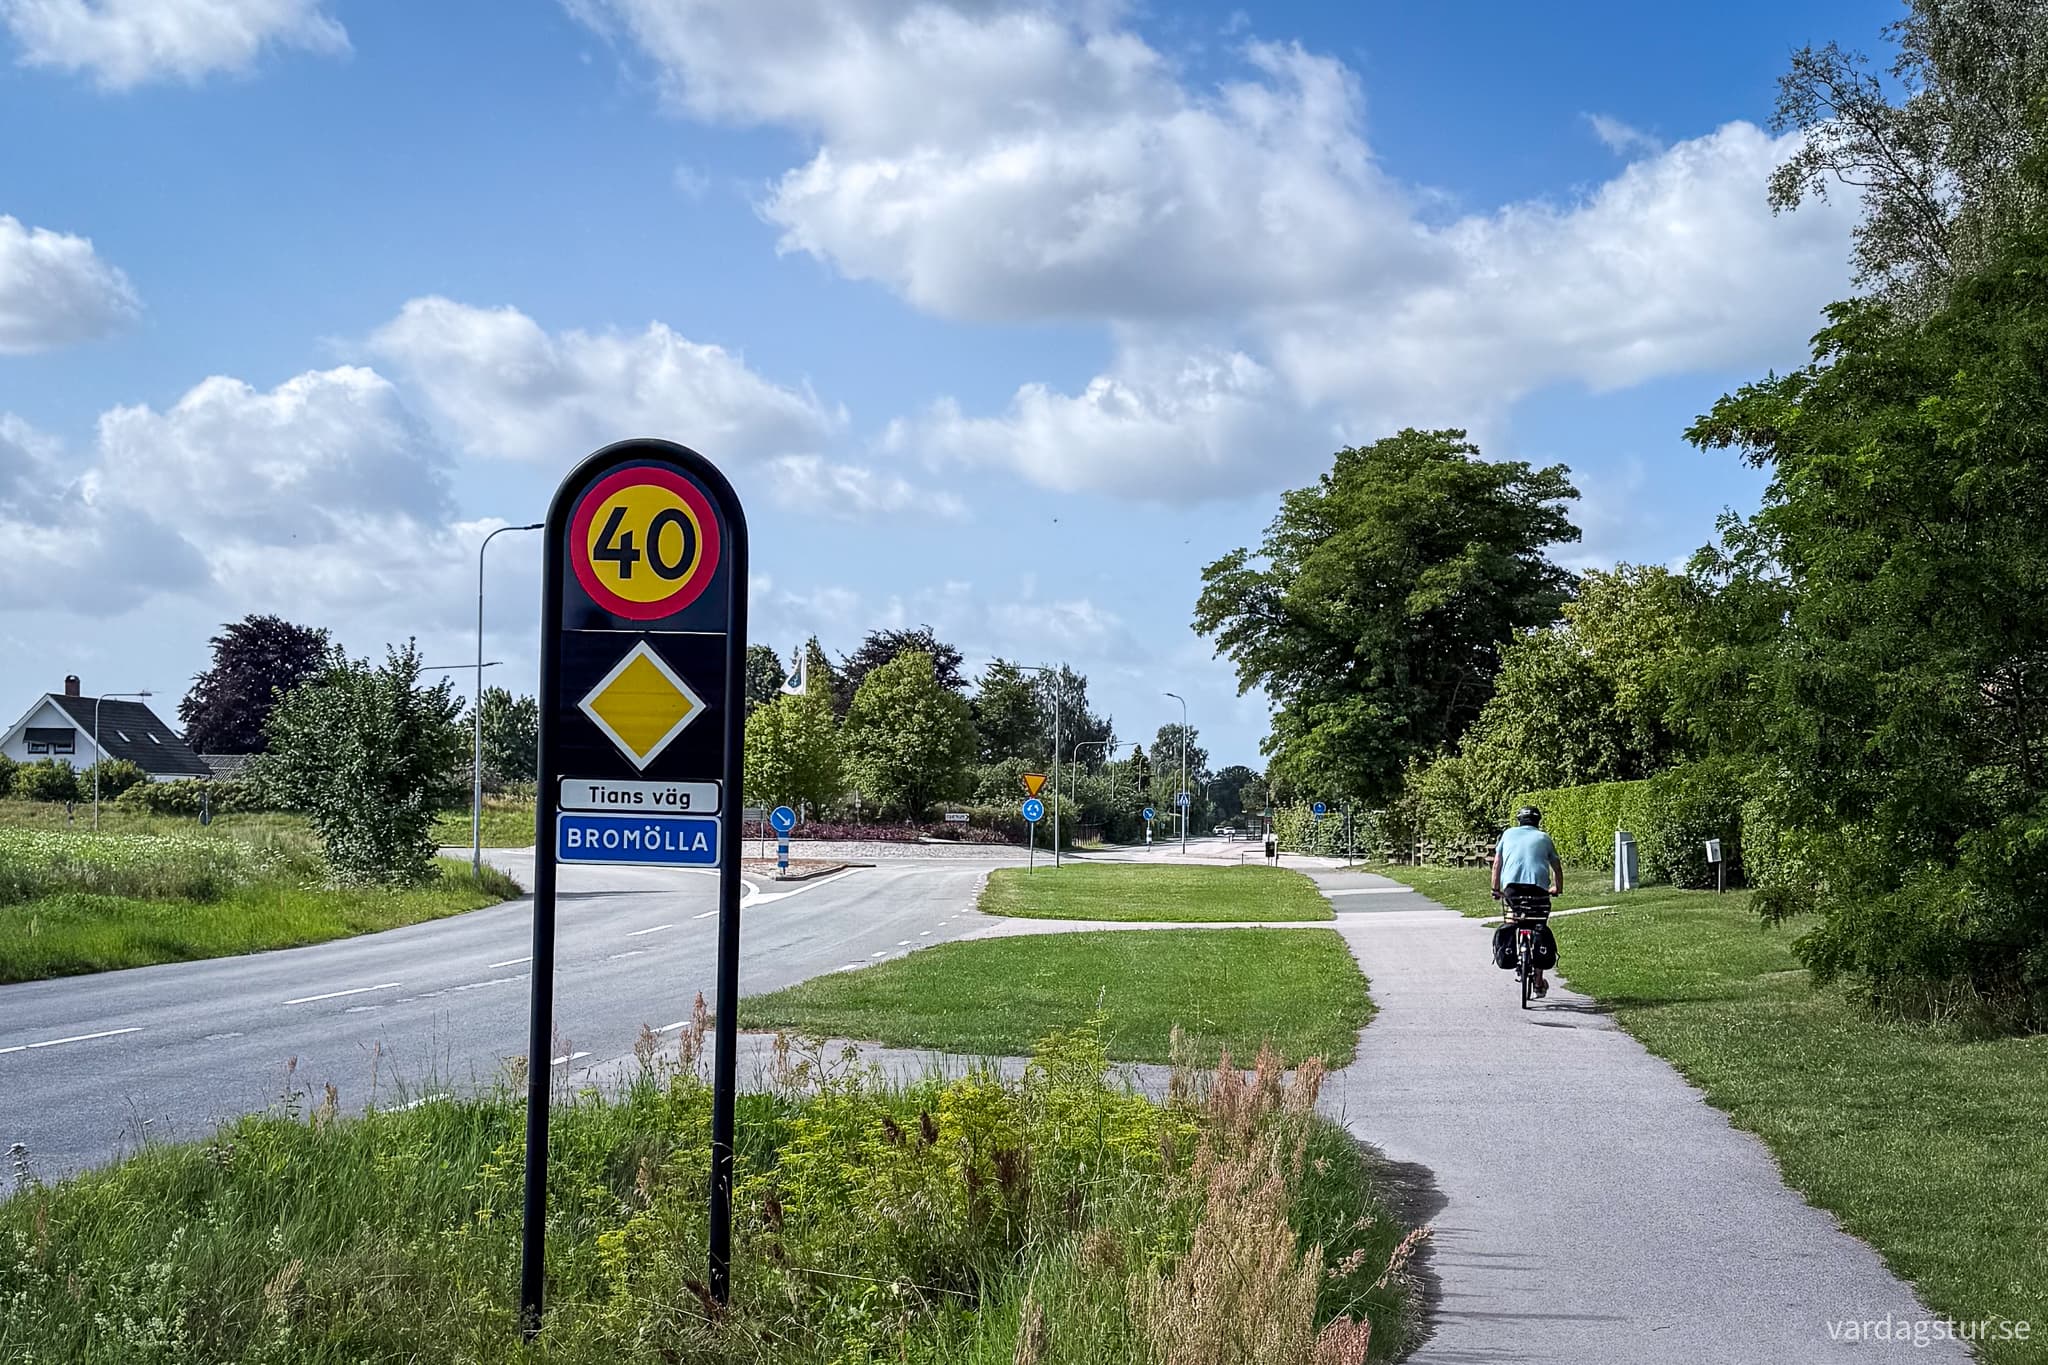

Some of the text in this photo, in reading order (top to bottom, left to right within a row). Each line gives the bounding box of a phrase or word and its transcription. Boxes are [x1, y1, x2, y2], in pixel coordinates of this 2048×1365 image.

[593, 507, 697, 580] 40
[589, 786, 691, 809] Tians väg
[567, 825, 708, 852] BROMÖLLA
